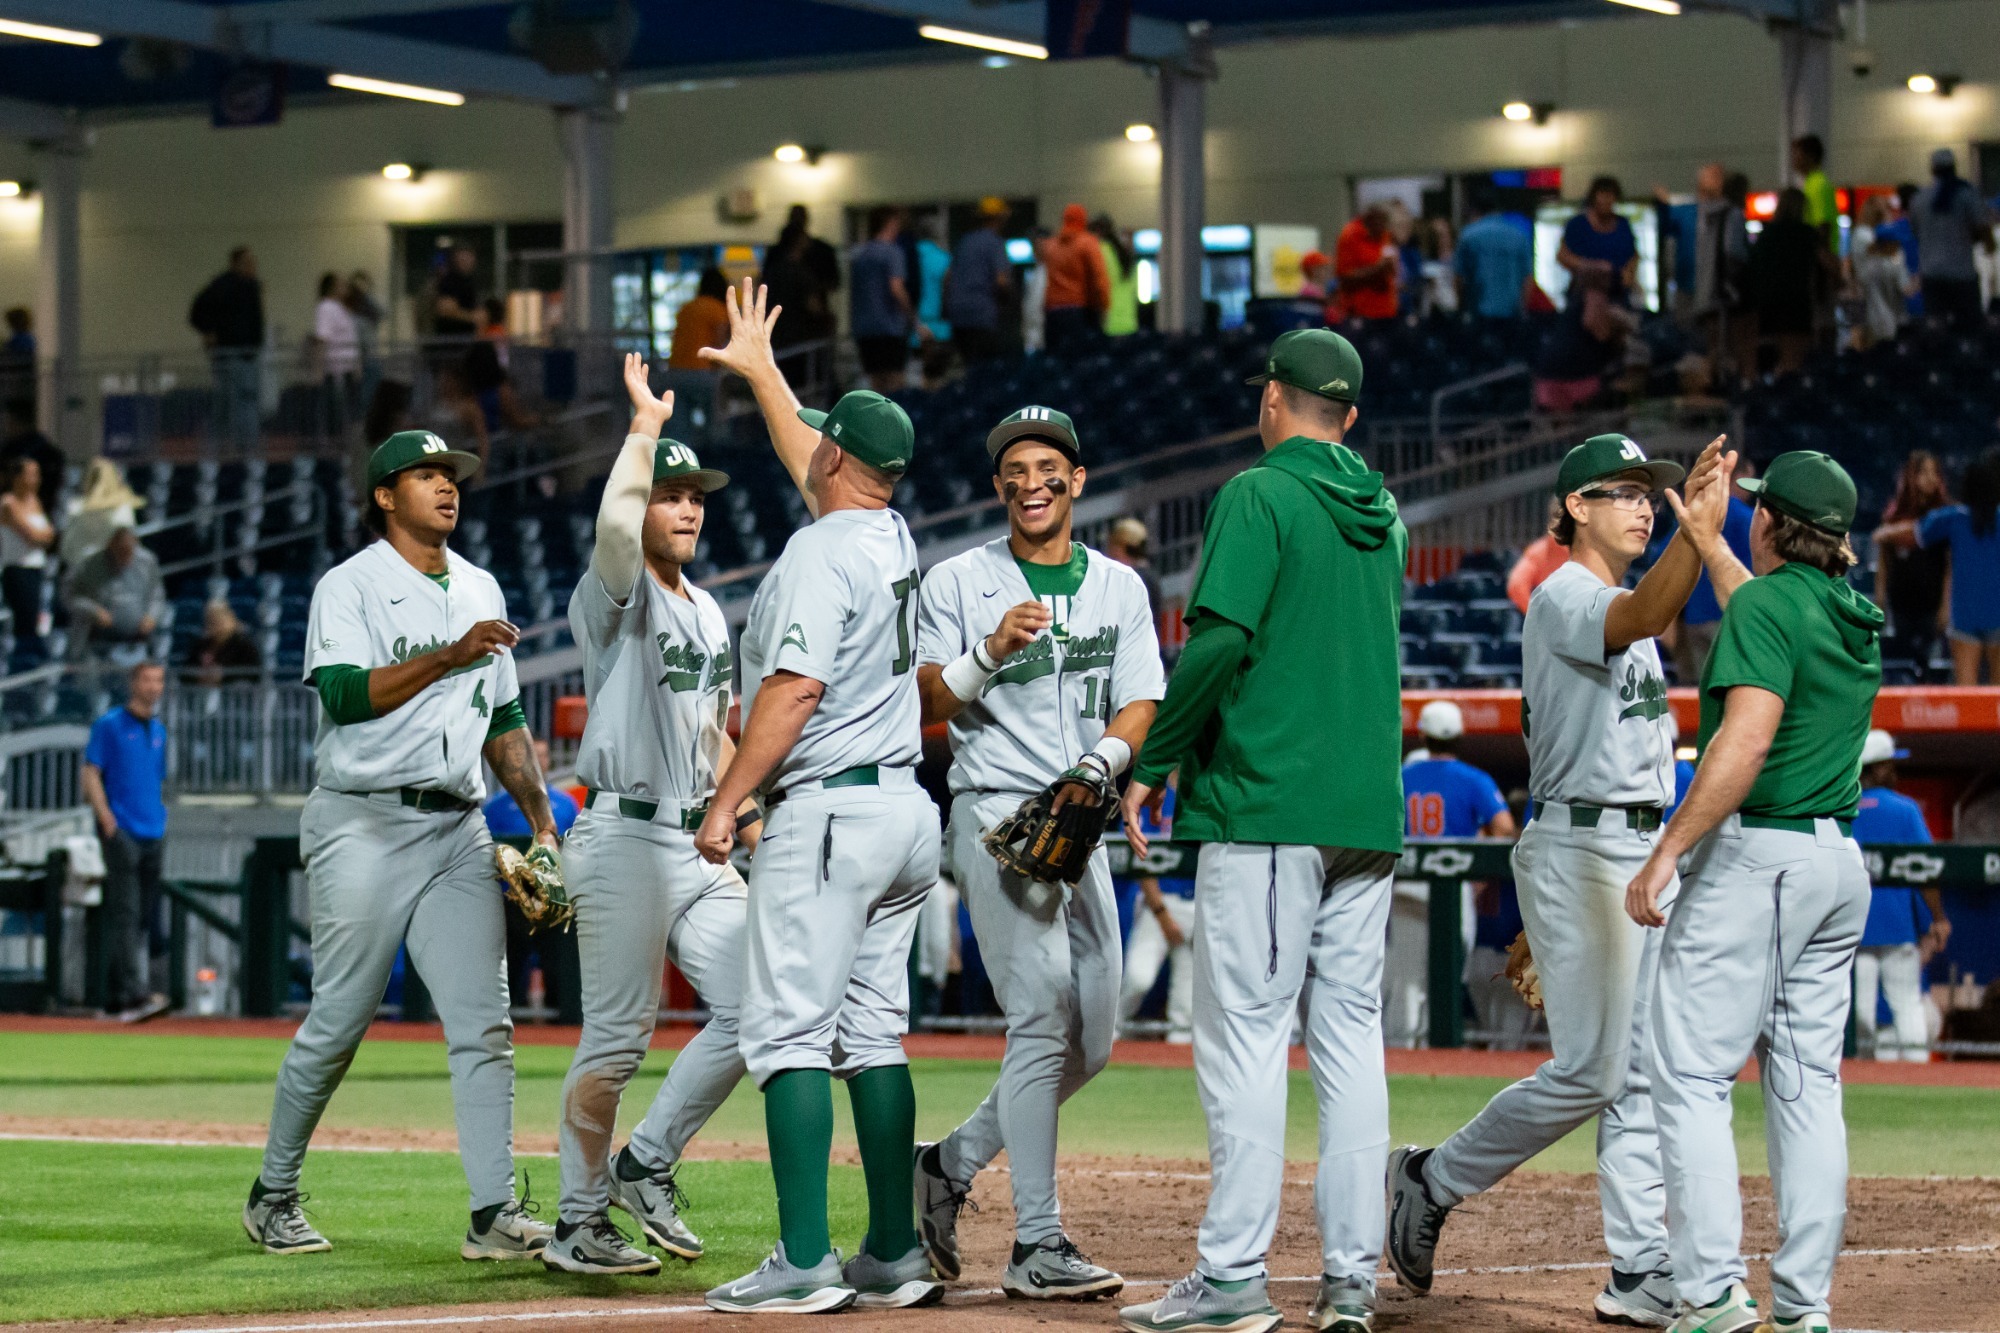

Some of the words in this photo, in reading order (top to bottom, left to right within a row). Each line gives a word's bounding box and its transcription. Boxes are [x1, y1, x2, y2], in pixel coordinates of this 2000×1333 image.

[665, 445, 697, 467] JU
[471, 679, 488, 718] 4
[717, 689, 729, 731] 8
[1407, 792, 1444, 836] 18
